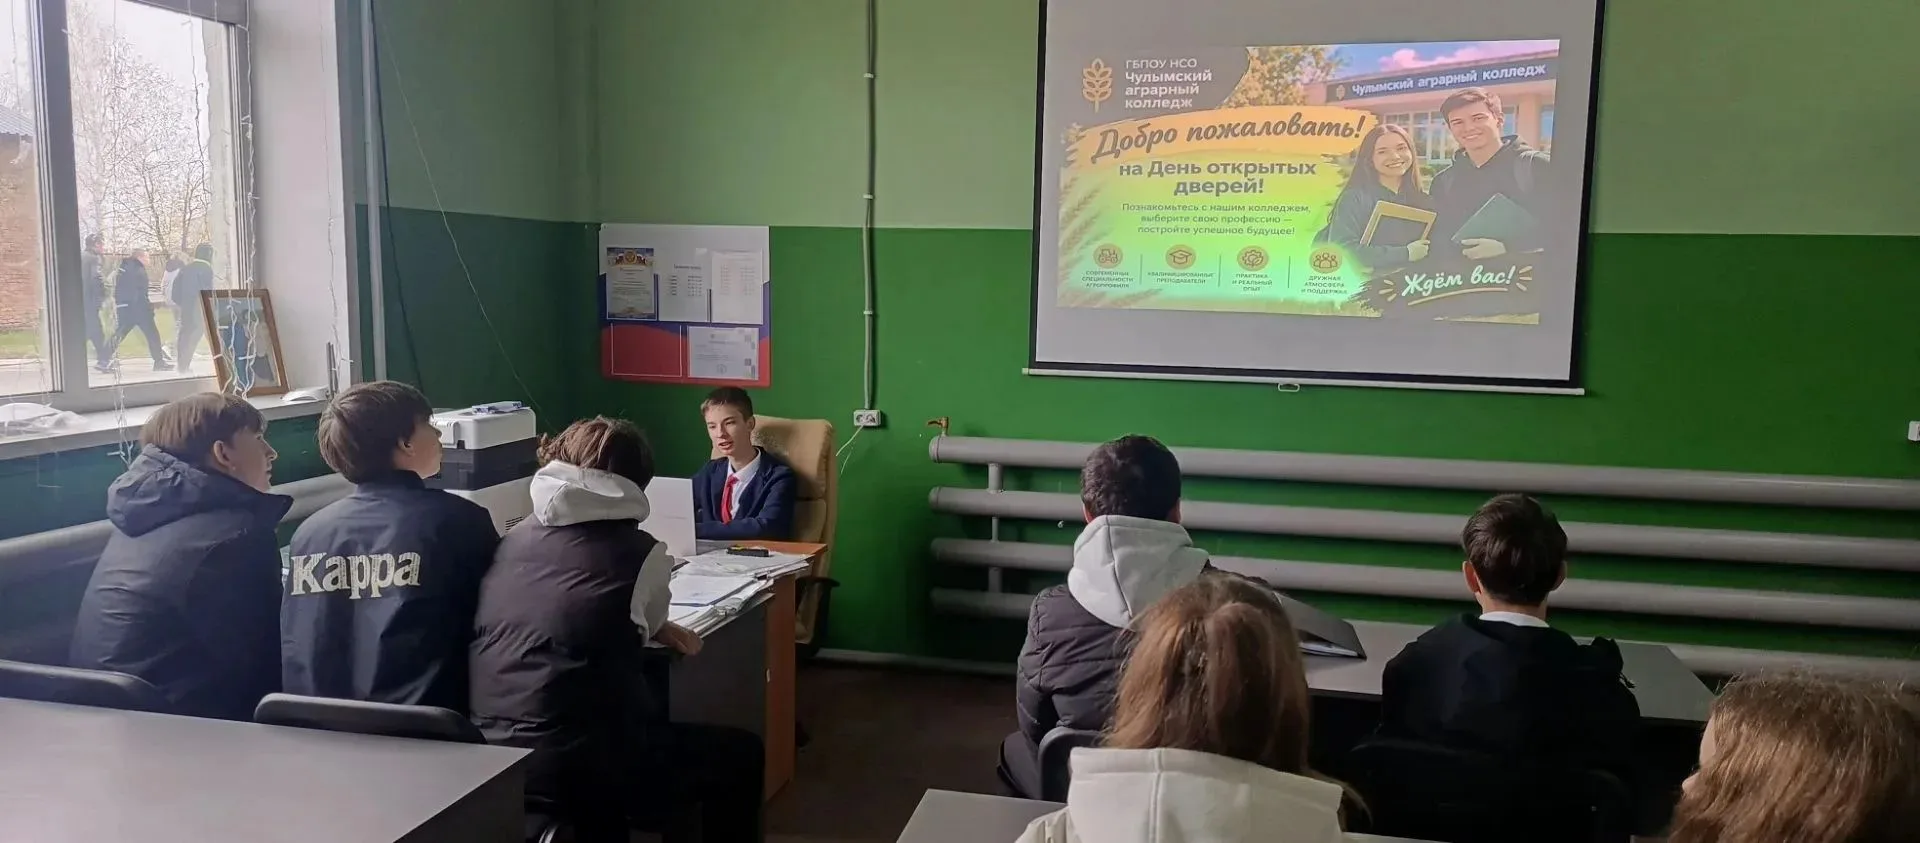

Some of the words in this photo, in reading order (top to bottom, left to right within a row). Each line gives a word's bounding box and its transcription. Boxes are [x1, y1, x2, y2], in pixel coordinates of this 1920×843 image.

[1126, 58, 1166, 70] ГБПОУ
[1170, 58, 1198, 69] НСО
[1125, 70, 1213, 84] Чулымский
[1352, 77, 1414, 96] Чулымский
[1417, 70, 1477, 88] аграрный
[1482, 63, 1547, 79] колледж
[1125, 84, 1200, 98] аграрный
[1125, 98, 1193, 109] колледж
[1090, 123, 1178, 164] Добро
[1186, 112, 1367, 142] пожаловать!
[1119, 163, 1143, 176] на
[1147, 160, 1202, 177] День
[1207, 161, 1317, 176] открытых
[1173, 177, 1264, 197] дверей!
[1122, 203, 1199, 212] Познакомьтесь
[1210, 204, 1246, 212] нашим
[1248, 204, 1311, 214] колледжем,
[1141, 214, 1190, 223] выберите
[1221, 214, 1281, 224] профессию
[1138, 226, 1190, 234] постройте
[1193, 227, 1244, 235] успешное
[1246, 226, 1295, 235] будущее!
[1401, 273, 1463, 297] Ждём
[1470, 264, 1517, 290] вас!
[290, 551, 421, 599] Kappa
